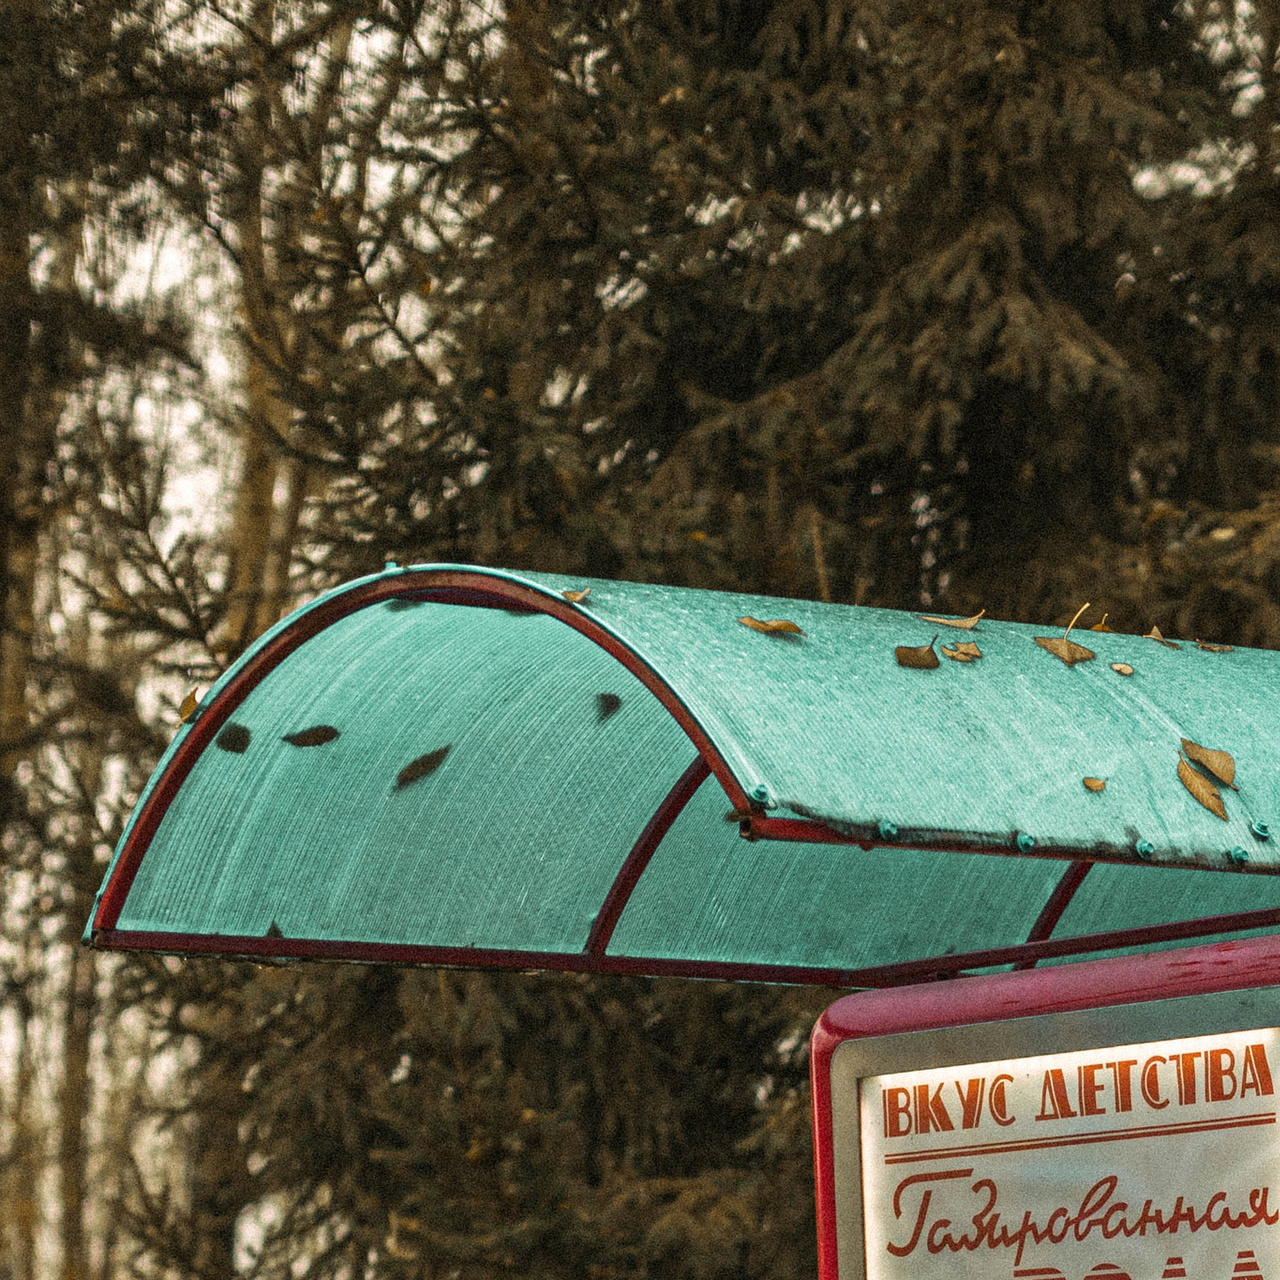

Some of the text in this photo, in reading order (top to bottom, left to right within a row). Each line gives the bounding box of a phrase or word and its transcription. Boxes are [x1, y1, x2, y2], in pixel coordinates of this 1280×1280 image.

[883, 1044, 1275, 1138] ВКУС ДЕТСТВА
[887, 1168, 1279, 1266] Газированная
